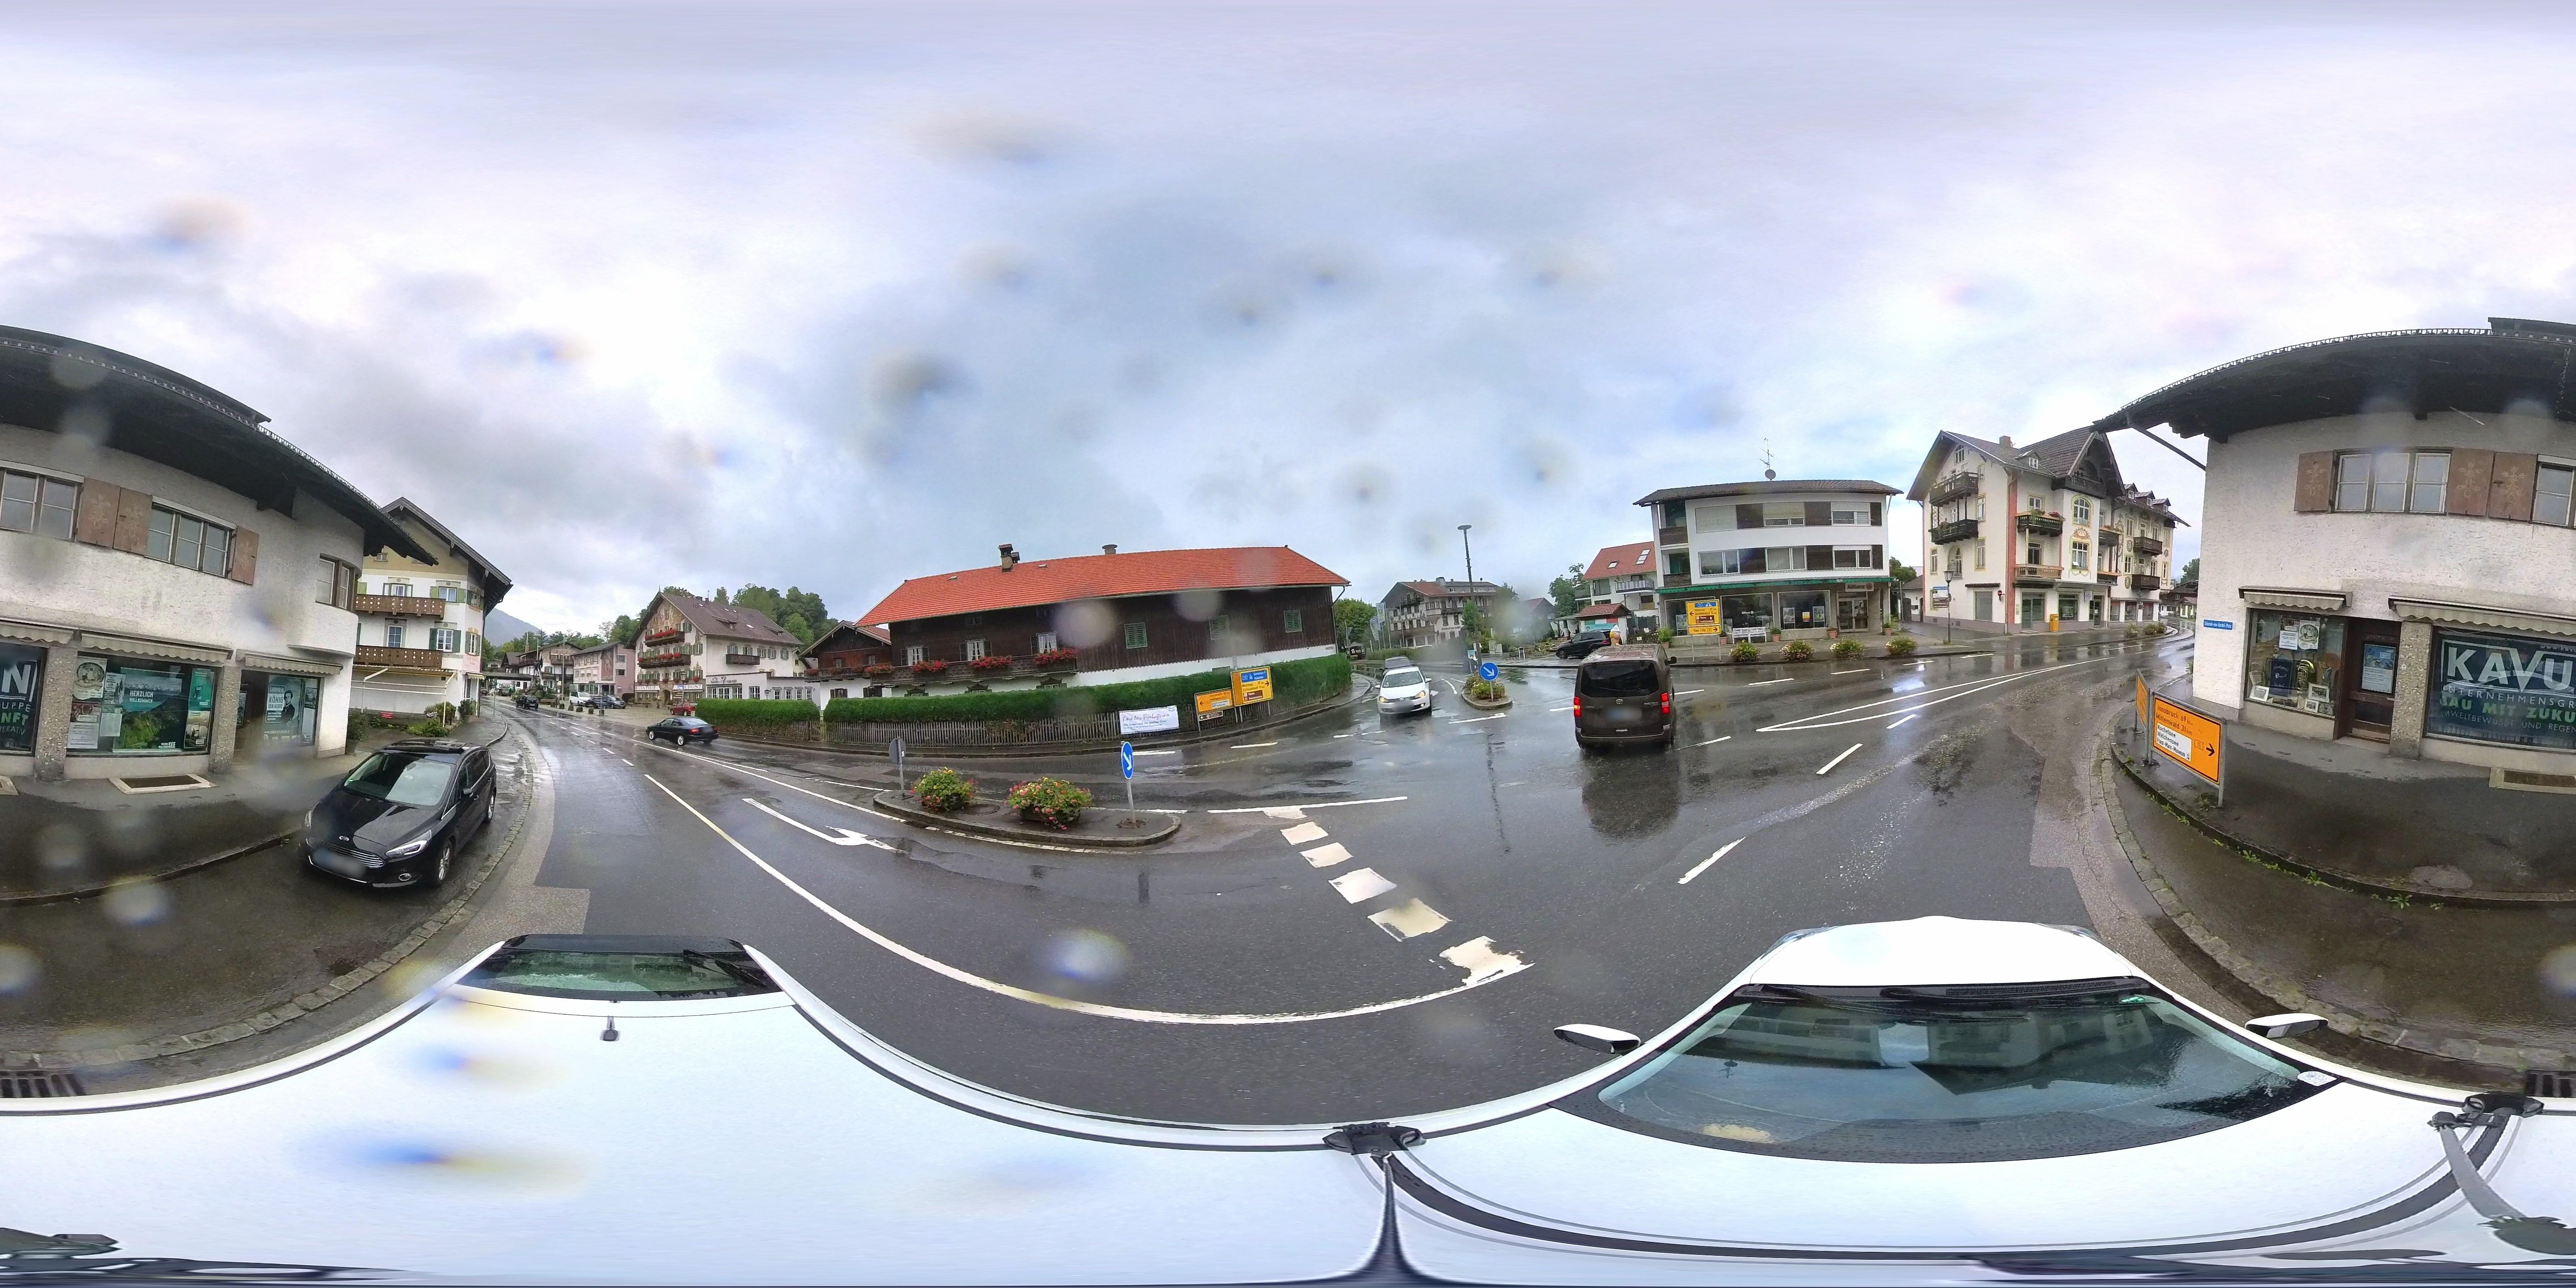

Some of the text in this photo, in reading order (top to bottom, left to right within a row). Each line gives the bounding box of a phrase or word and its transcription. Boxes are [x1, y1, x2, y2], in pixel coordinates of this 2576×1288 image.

[2447, 647, 2573, 693] KAVU
[2157, 704, 2179, 720] Innsbruck
[2156, 712, 2180, 729] Mittenwald
[2182, 724, 2186, 733] 31
[2157, 724, 2176, 738] Kochelsee
